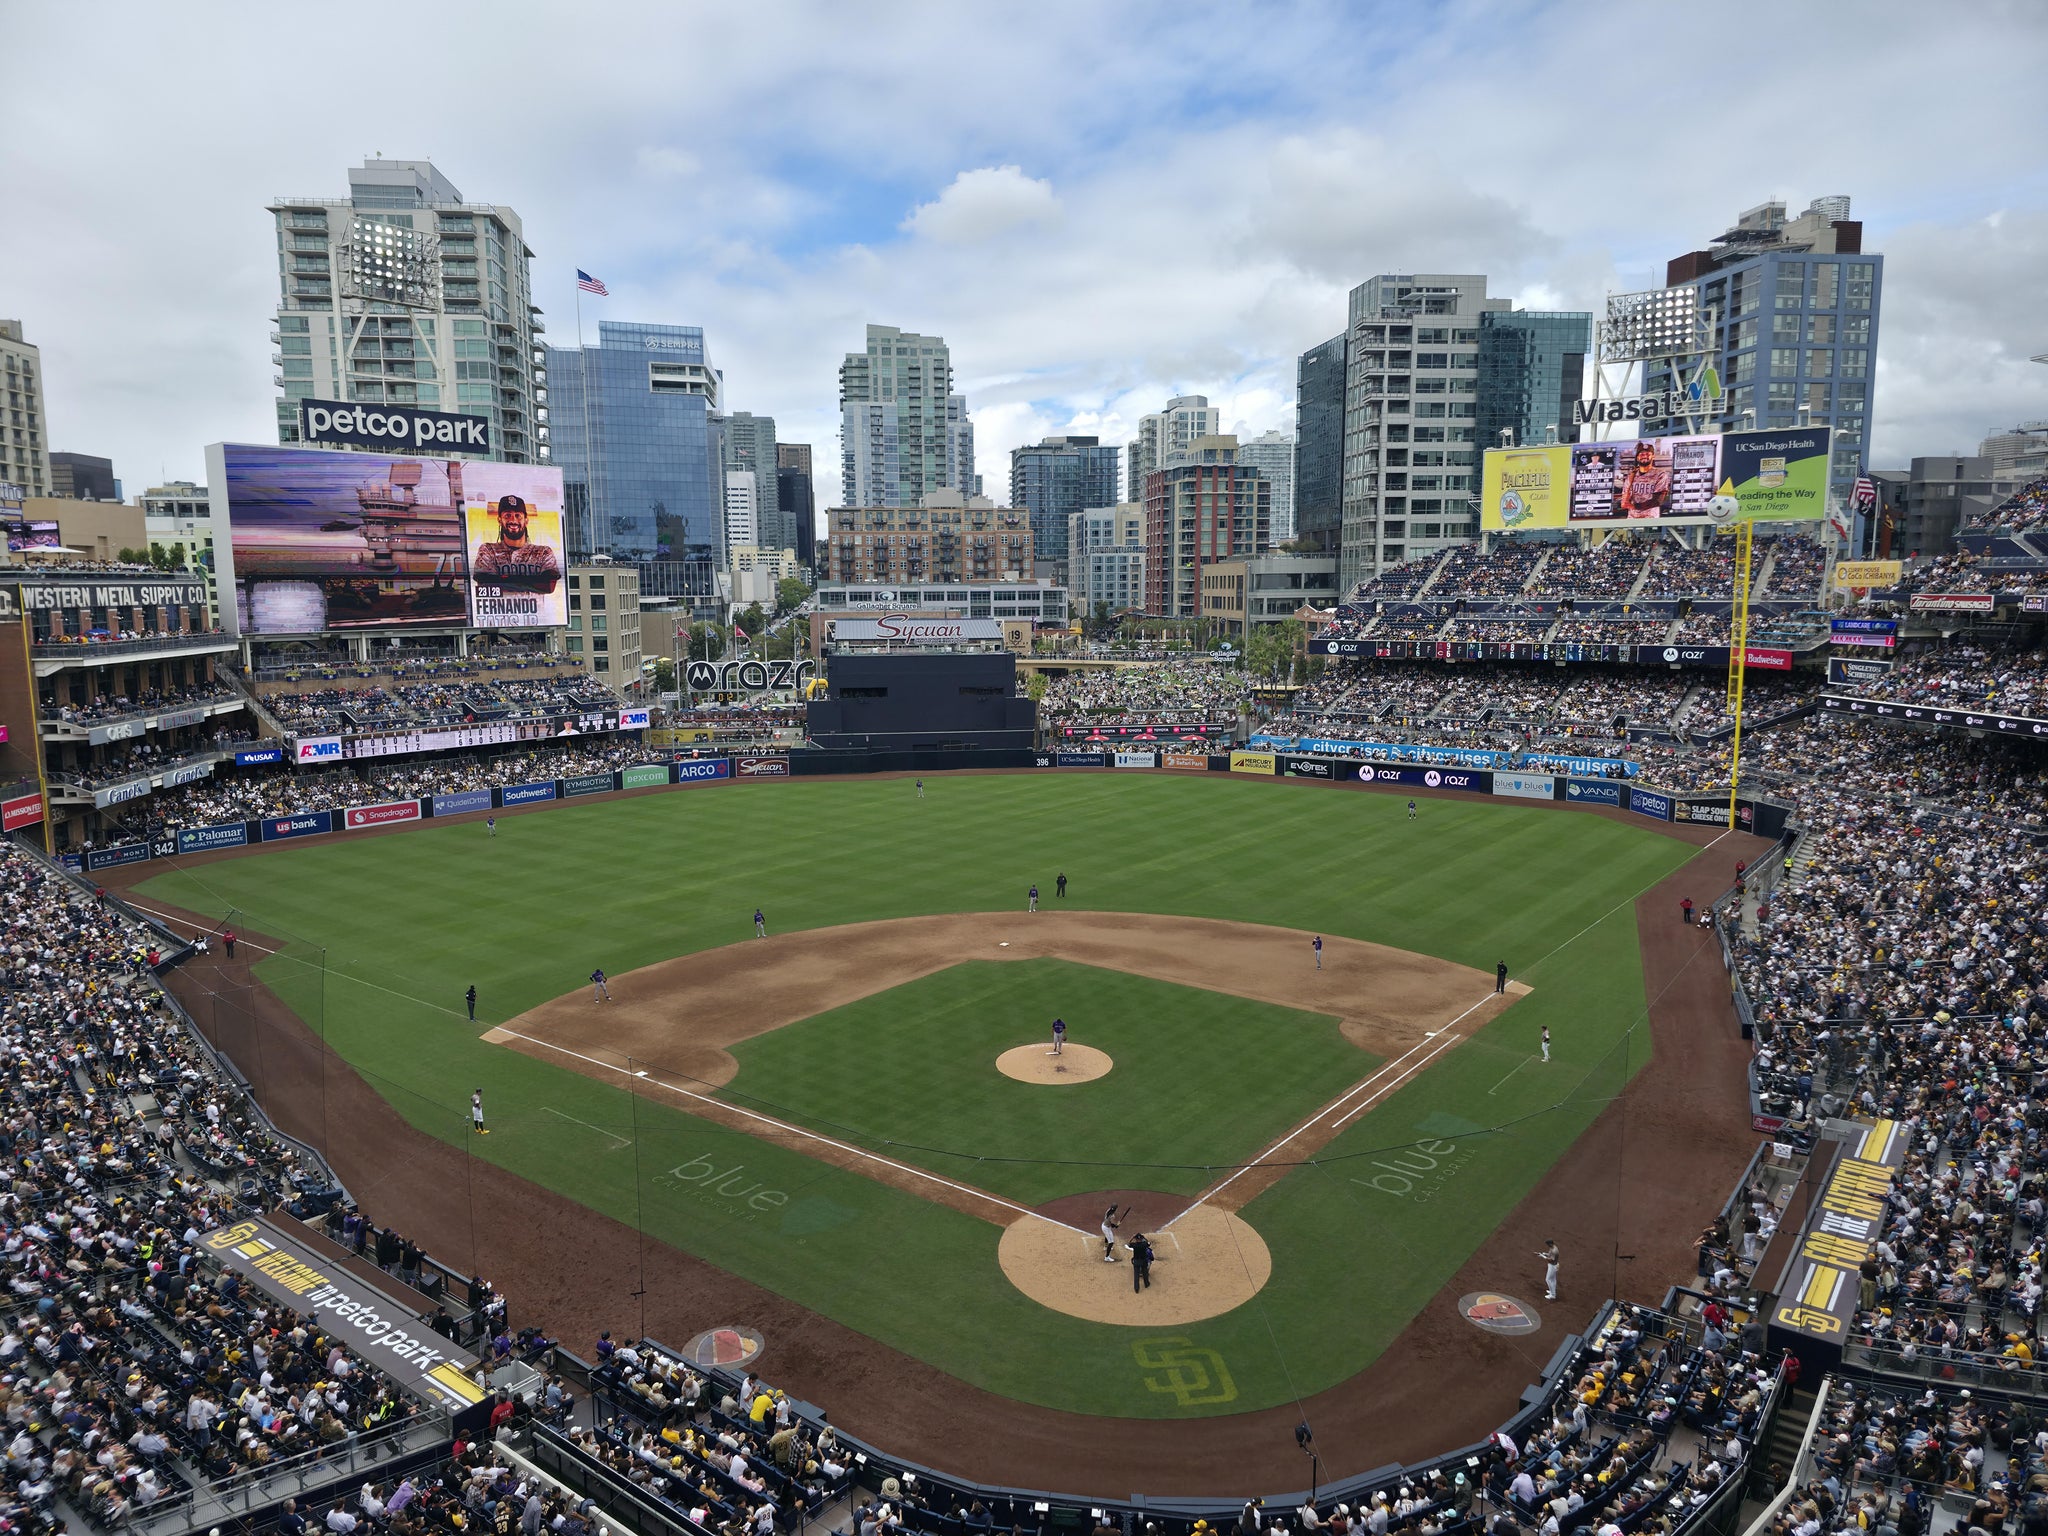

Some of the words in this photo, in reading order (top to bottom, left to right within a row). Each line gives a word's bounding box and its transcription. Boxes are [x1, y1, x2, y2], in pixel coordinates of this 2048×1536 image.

[660, 341, 701, 350] SEMPRA
[1577, 392, 1676, 423] Viasat
[307, 405, 409, 439] petco
[414, 416, 487, 447] park
[1735, 443, 1749, 452] UC
[1749, 442, 1765, 451] San
[1765, 441, 1788, 451] Diego
[1788, 440, 1815, 449] Health
[1735, 491, 1774, 501] Leading
[1776, 490, 1793, 499] the
[1794, 489, 1816, 499] Way
[1765, 503, 1789, 511] Diego
[22, 586, 91, 610] WESTERN
[96, 586, 139, 607] METAL
[140, 586, 184, 605] SUPPLY
[188, 586, 207, 604] CO.
[1954, 600, 1991, 609] SAUSAGES
[476, 598, 538, 615] FERNANDO
[856, 602, 891, 612] Gallagher
[892, 602, 918, 611] Square
[876, 613, 963, 646] Sycuan
[1010, 630, 1021, 640] 19
[1340, 644, 1358, 652] razr
[1681, 650, 1705, 659] razr
[1748, 653, 1785, 666] Budweiser
[720, 660, 815, 691] razr
[620, 713, 648, 725] AMR
[106, 723, 133, 741] ORIS
[520, 726, 526, 739] 0
[533, 725, 539, 738] 0
[546, 724, 552, 737] 2
[254, 752, 276, 762] USAA
[300, 742, 340, 758] AMR
[739, 759, 784, 776] Sycuan
[1036, 757, 1049, 767] 396
[1290, 761, 1328, 773] EVOTEK
[173, 766, 203, 786] Canel's
[681, 764, 715, 778] ARCO
[1377, 769, 1401, 781] razr
[1444, 773, 1470, 787] razr
[565, 777, 612, 789] CYMBIOTIKA
[1495, 779, 1514, 788] blue
[1524, 781, 1544, 791] blue
[108, 782, 143, 804] Canel's
[505, 787, 547, 801] Southwest
[1581, 786, 1619, 797] VANDA
[10, 804, 32, 817] MISSION
[32, 802, 42, 812] FED
[447, 797, 489, 809] QuidelOrtho
[1641, 796, 1667, 811] petco
[1691, 805, 1710, 815] SLAP
[1710, 806, 1731, 816] SOME
[369, 806, 413, 821] Snapdragon
[1691, 814, 1714, 823] CHEESE
[276, 822, 290, 832] us
[291, 818, 317, 831] bank
[198, 827, 243, 842] Palomar
[155, 841, 175, 856] 342
[184, 840, 213, 849] SPECIALTY
[213, 836, 244, 845] INSURANCE
[93, 848, 146, 864] AGRAMONT
[1348, 1138, 1456, 1197] blue
[1414, 1147, 1478, 1203] CALIFORNIA
[668, 1152, 789, 1211] blue
[1821, 1158, 1896, 1221] FAITHFUL
[651, 1175, 758, 1222] CALIFORNIA
[1819, 1211, 1870, 1240] THE
[1801, 1231, 1870, 1271] FOR
[251, 1249, 331, 1296] WELCOME
[313, 1293, 392, 1336] petco
[369, 1329, 445, 1371] park
[496, 1521, 509, 1535] 23
